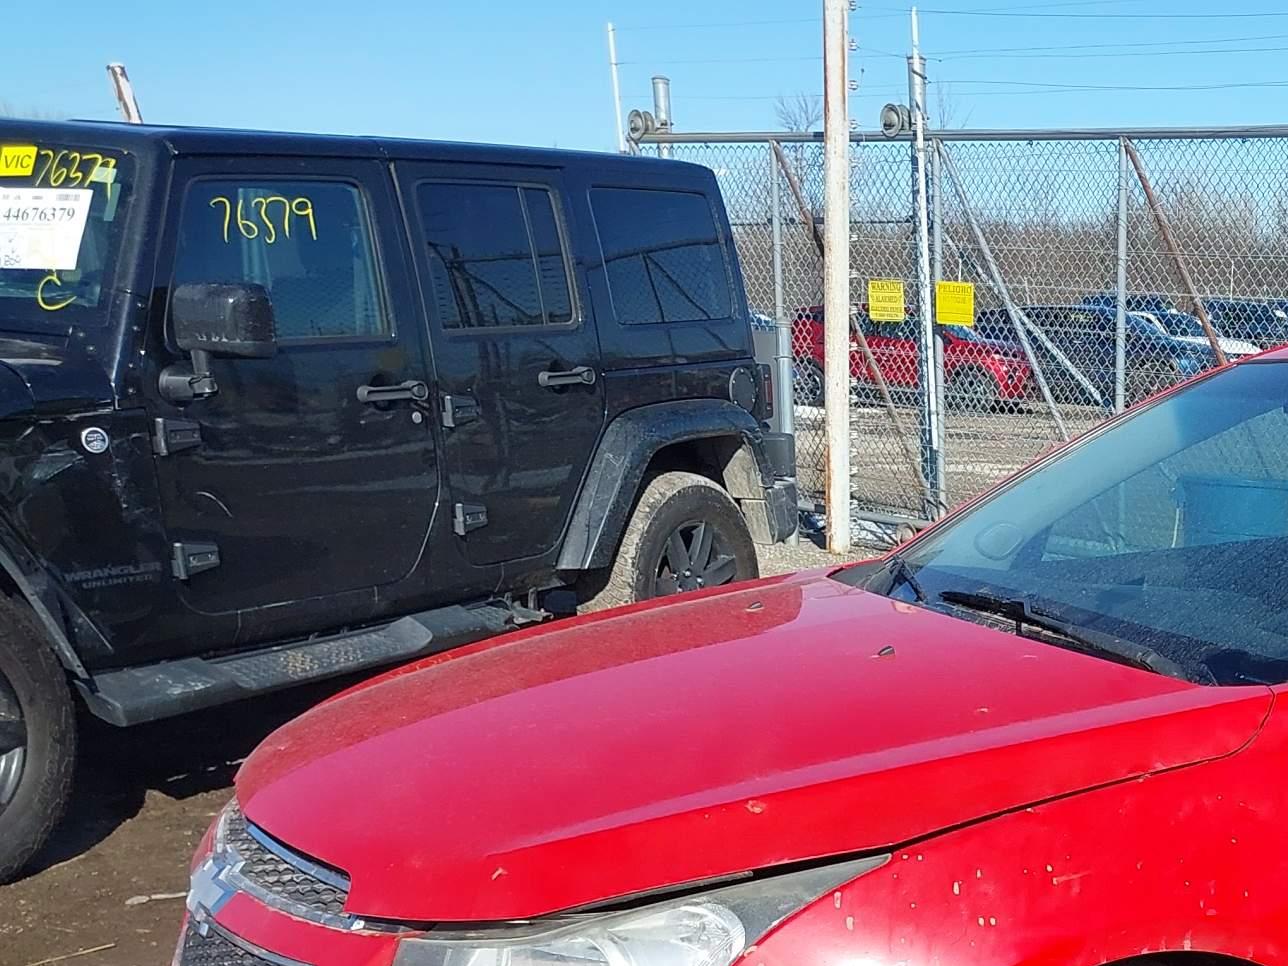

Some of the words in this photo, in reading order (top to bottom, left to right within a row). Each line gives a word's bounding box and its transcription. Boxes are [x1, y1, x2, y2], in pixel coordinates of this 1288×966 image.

[4, 154, 32, 169] VIC
[35, 150, 117, 201] 76379
[3, 207, 76, 222] 44676379
[209, 195, 318, 244] 76379
[63, 561, 162, 582] WRANGLER
[82, 574, 153, 589] UNLIMITED
